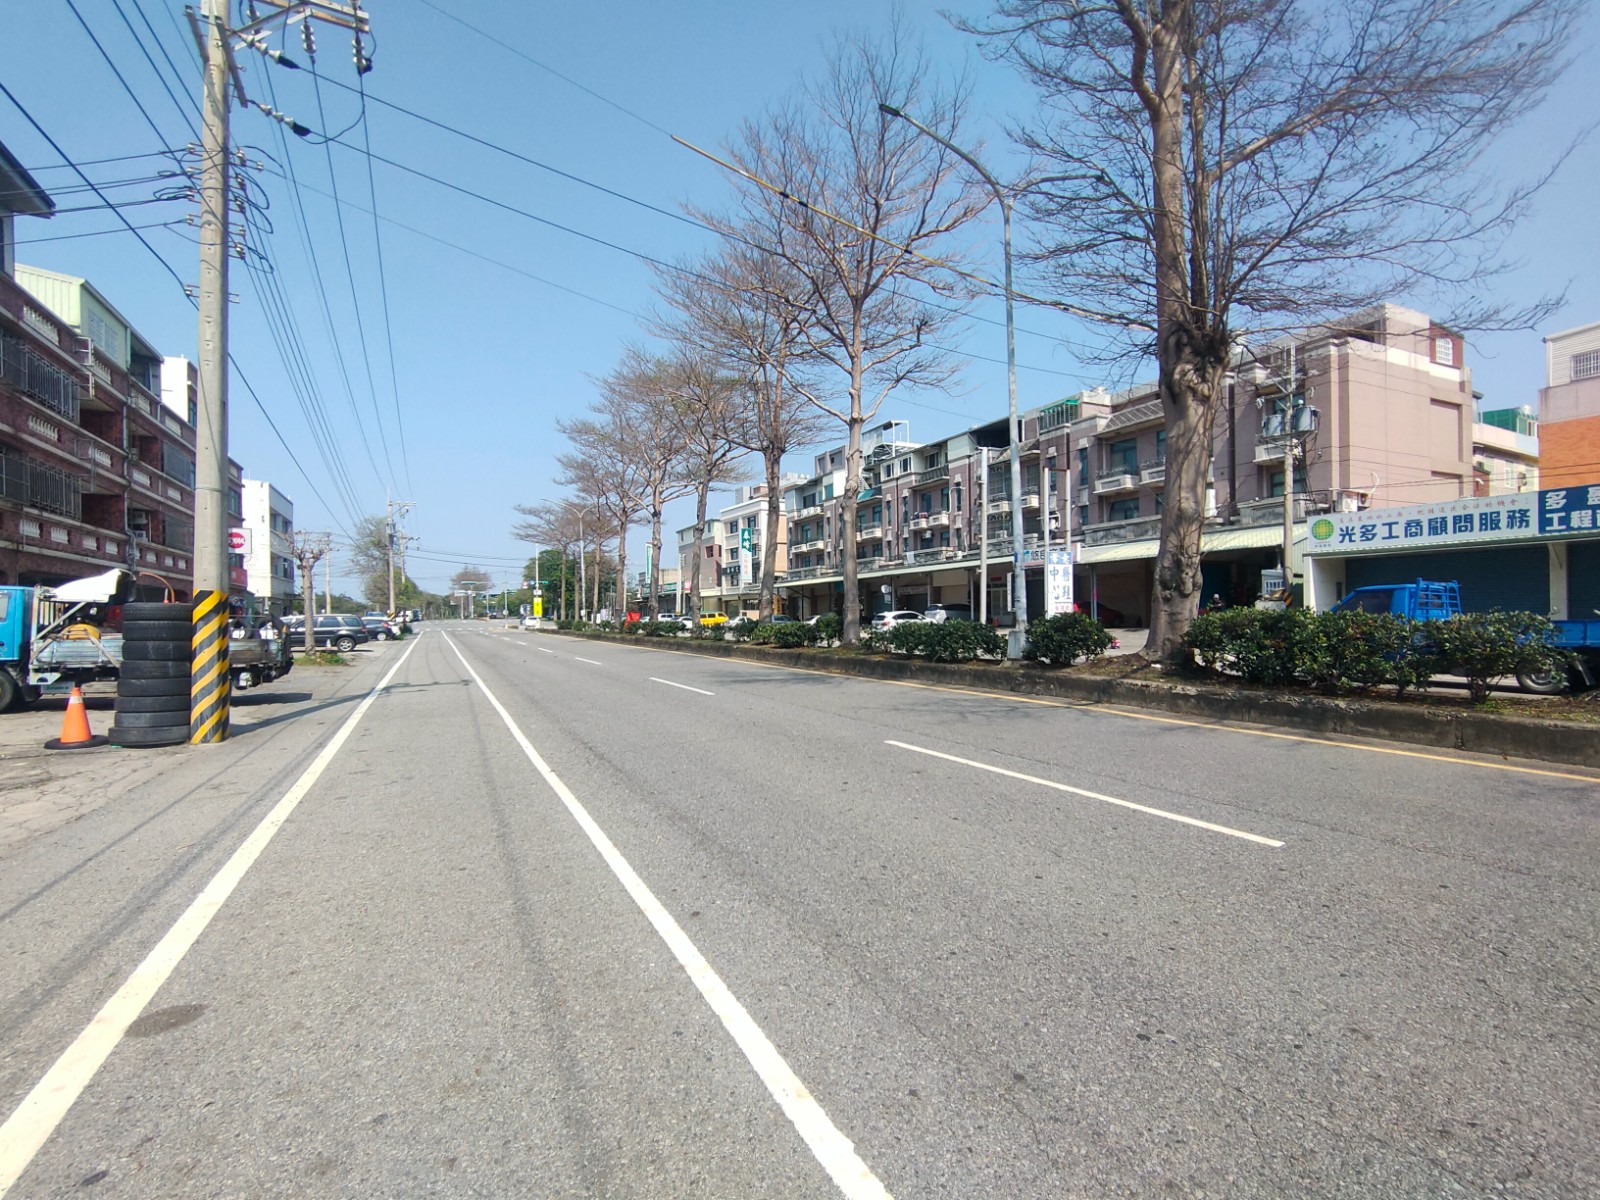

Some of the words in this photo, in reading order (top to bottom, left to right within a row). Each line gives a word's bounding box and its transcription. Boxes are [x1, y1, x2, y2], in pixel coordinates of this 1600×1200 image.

[1339, 508, 1530, 544] 光多工商顧問服務
[1546, 509, 1600, 531] 工程
